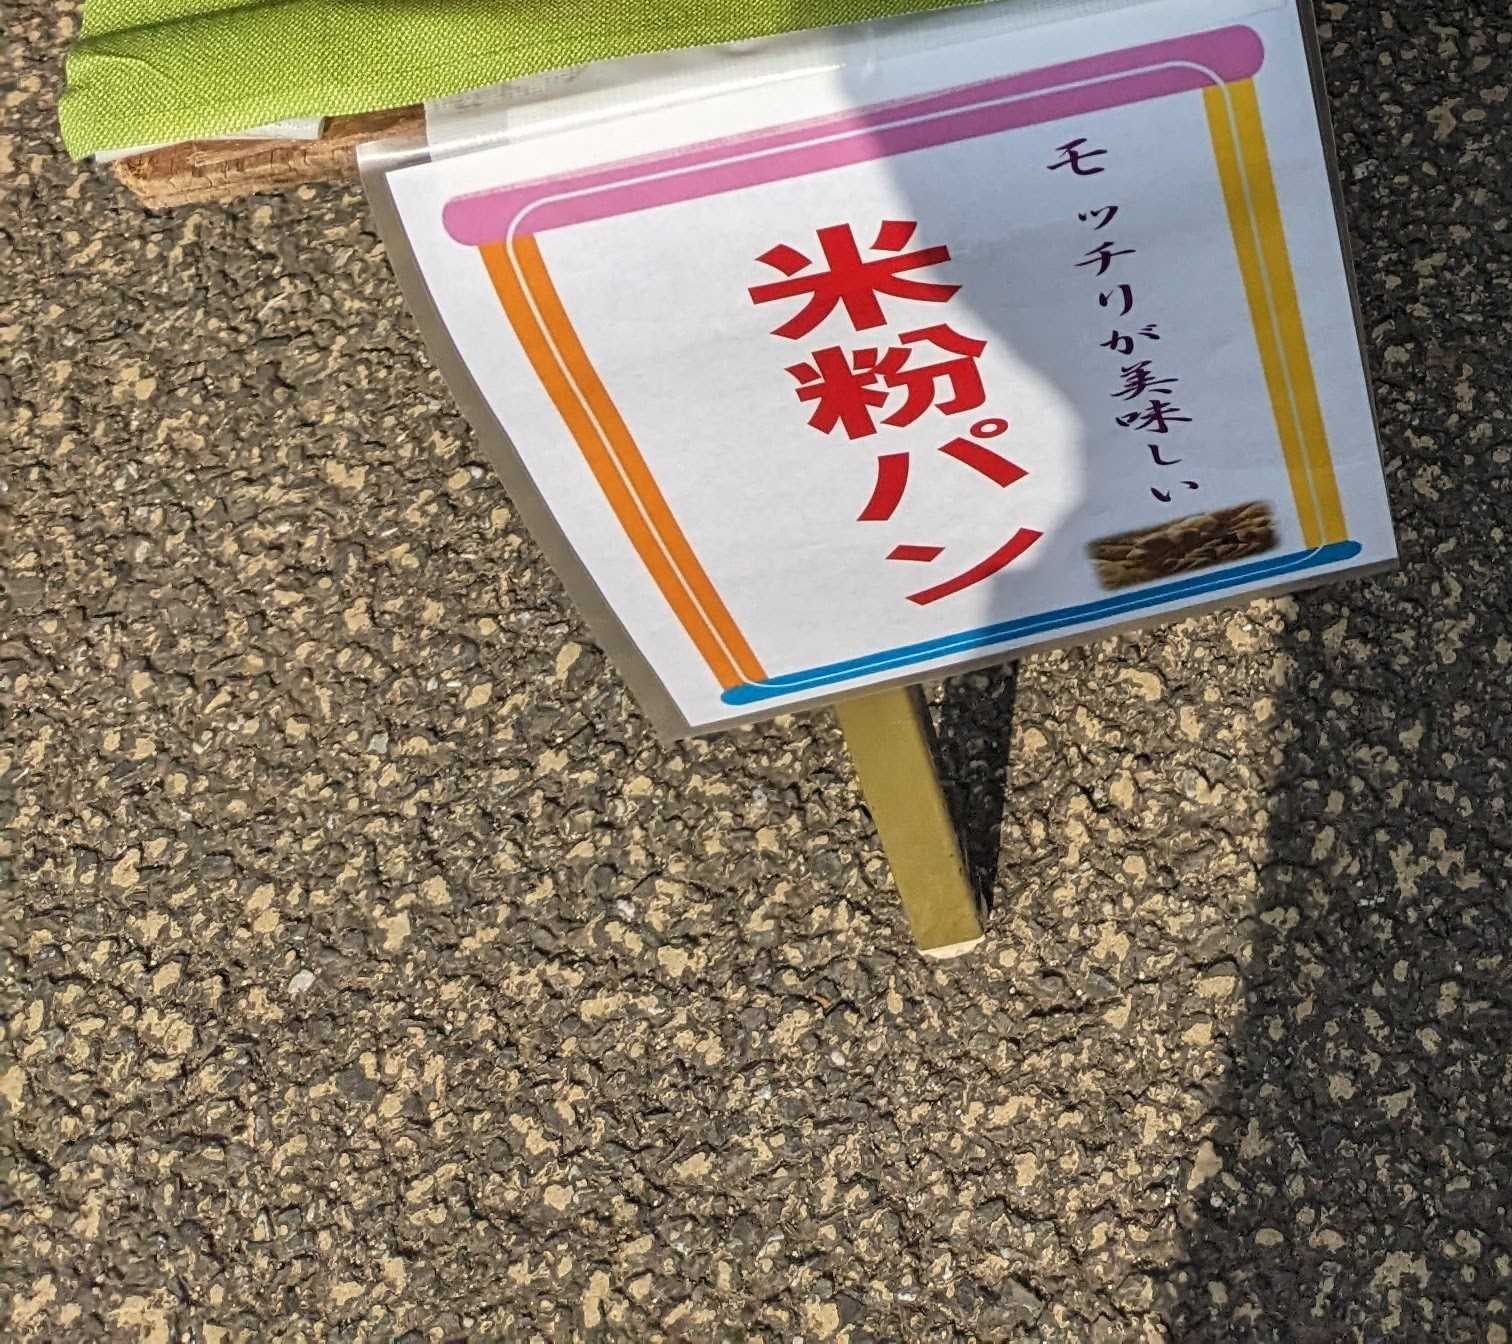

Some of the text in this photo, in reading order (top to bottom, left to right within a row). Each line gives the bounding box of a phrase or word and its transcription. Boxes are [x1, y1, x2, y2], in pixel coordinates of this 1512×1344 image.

[747, 220, 1044, 606] 米粉パン
[1046, 136, 1202, 505] モッチリが美味しい
